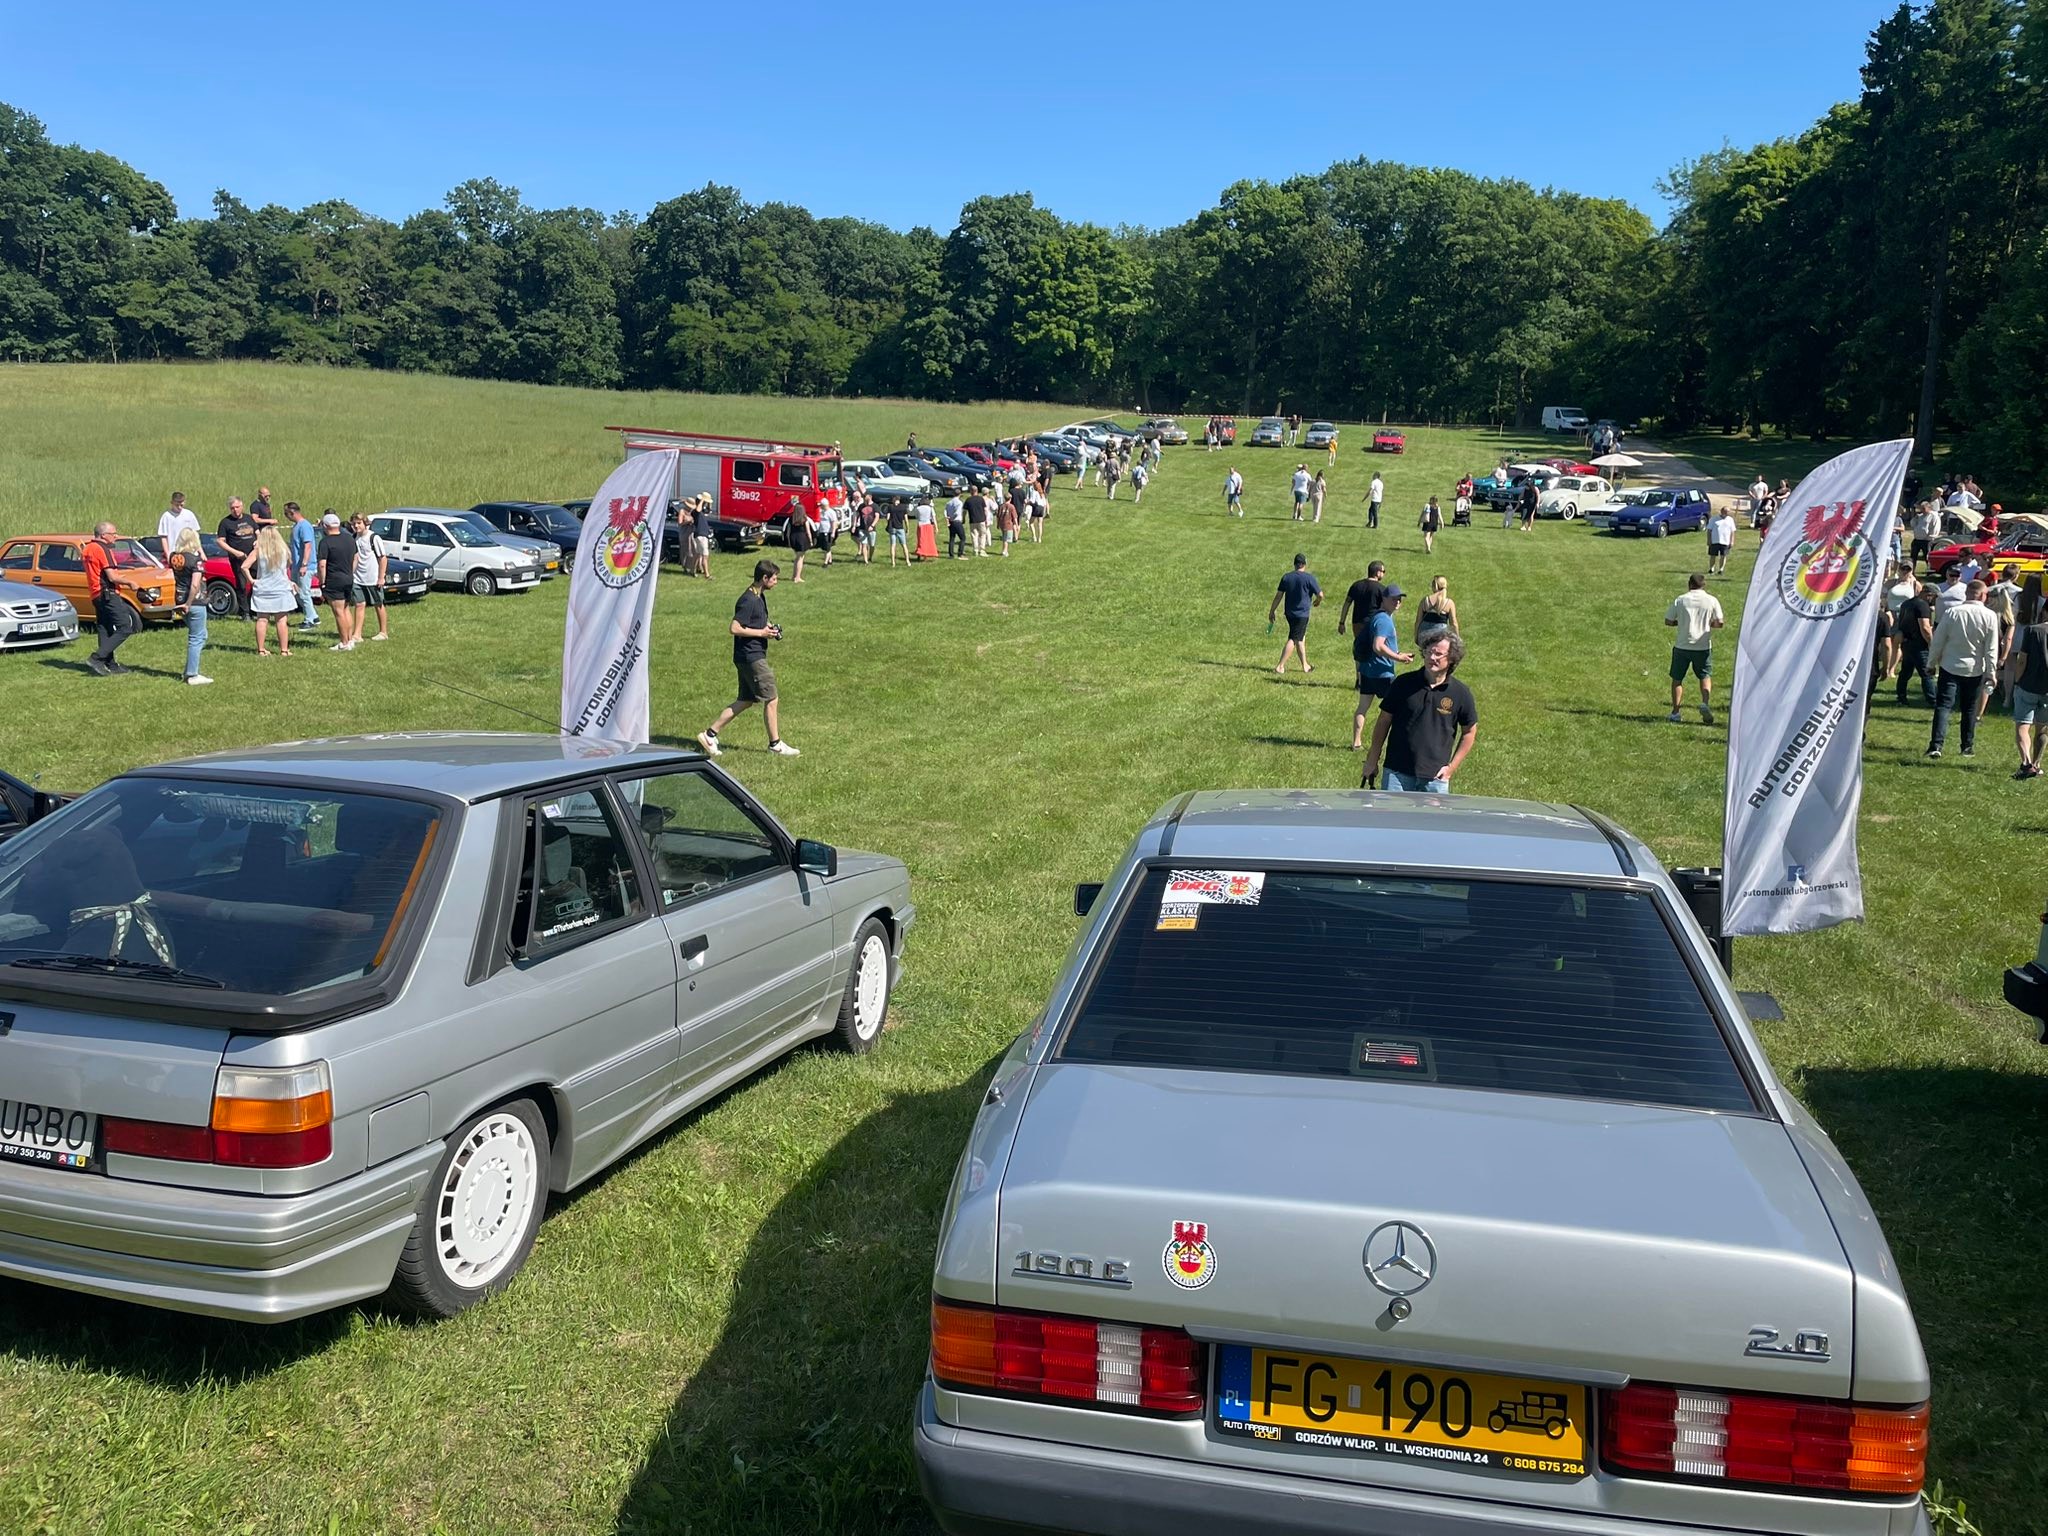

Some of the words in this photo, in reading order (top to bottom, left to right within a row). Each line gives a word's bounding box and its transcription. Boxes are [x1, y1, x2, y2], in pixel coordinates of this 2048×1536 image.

[1785, 558, 1834, 613] AUTOMOBILKLUB
[1837, 551, 1872, 611] GORZOWSKI
[572, 620, 641, 737] AUTOMOBILKLUB
[596, 645, 643, 728] GORZOWSKI
[1747, 657, 1857, 810] AUTOMOBILKLUB
[1781, 689, 1858, 798] GORZOWSKI
[1743, 881, 1848, 897] automobilklubgorzowski
[1160, 907, 1198, 915] KLASYKI
[4, 1145, 19, 1155] 957
[20, 1148, 35, 1158] 350
[36, 1150, 52, 1161] 340
[1015, 1250, 1095, 1277] 190
[1103, 1257, 1131, 1281] E
[1747, 1324, 1829, 1354] 2.0
[1225, 1390, 1244, 1407] PL
[1263, 1356, 1338, 1423] FG
[1373, 1368, 1472, 1438] 190
[1223, 1420, 1243, 1430] AUTO
[1244, 1423, 1279, 1434] NAPRAWA
[1295, 1432, 1342, 1446] GORZÓW
[1344, 1438, 1379, 1451] WLKP.
[1385, 1442, 1403, 1453] UL.
[1404, 1444, 1473, 1462] WSCHODNIA
[1473, 1453, 1489, 1464] 24
[1514, 1457, 1537, 1470] 608
[1538, 1460, 1561, 1472] 675
[1562, 1463, 1585, 1475] 294
